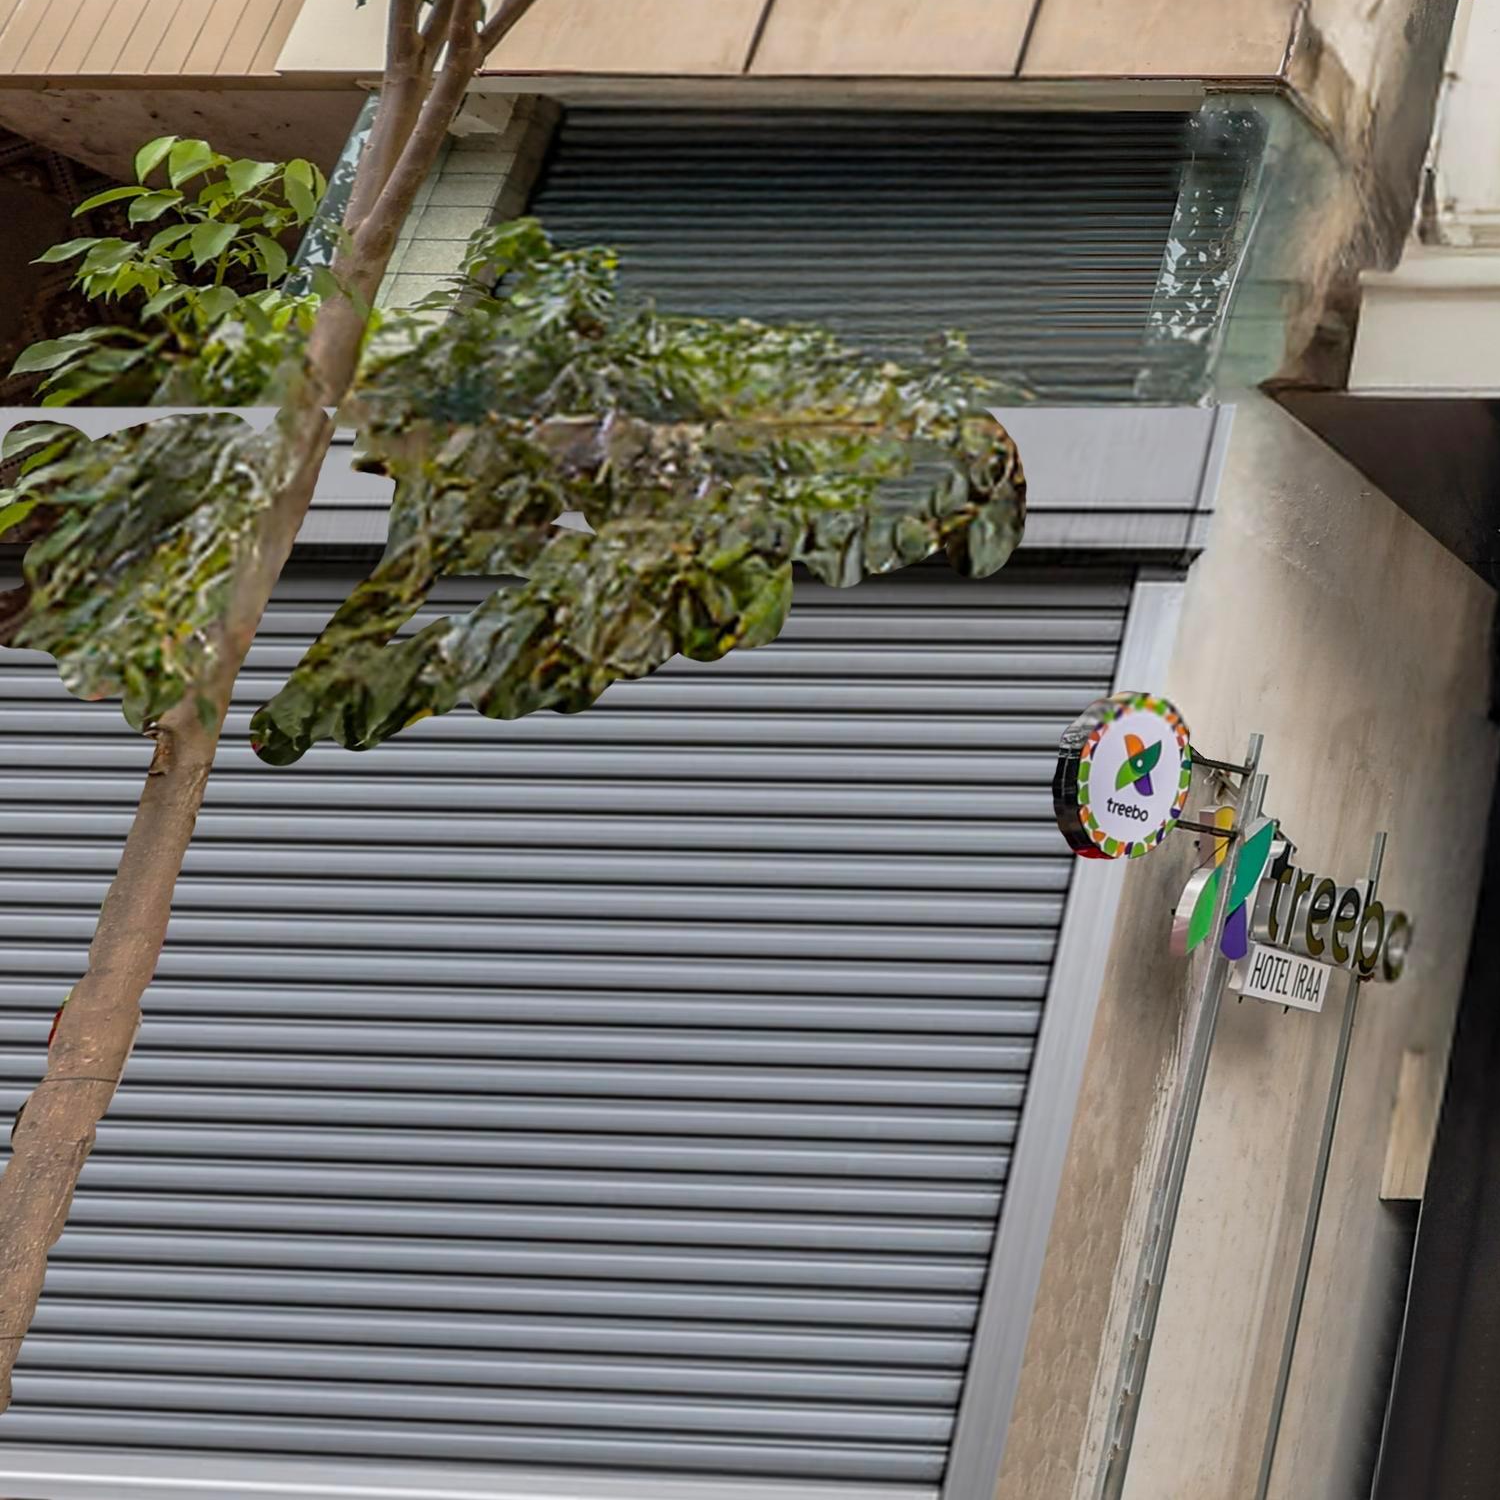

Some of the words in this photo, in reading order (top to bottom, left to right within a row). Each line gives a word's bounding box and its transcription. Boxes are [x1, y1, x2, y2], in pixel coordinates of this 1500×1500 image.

[1106, 797, 1149, 822] treebo
[1261, 842, 1412, 983] treebo
[1250, 951, 1292, 996] HOTEL
[1291, 963, 1324, 1003] IRAA
